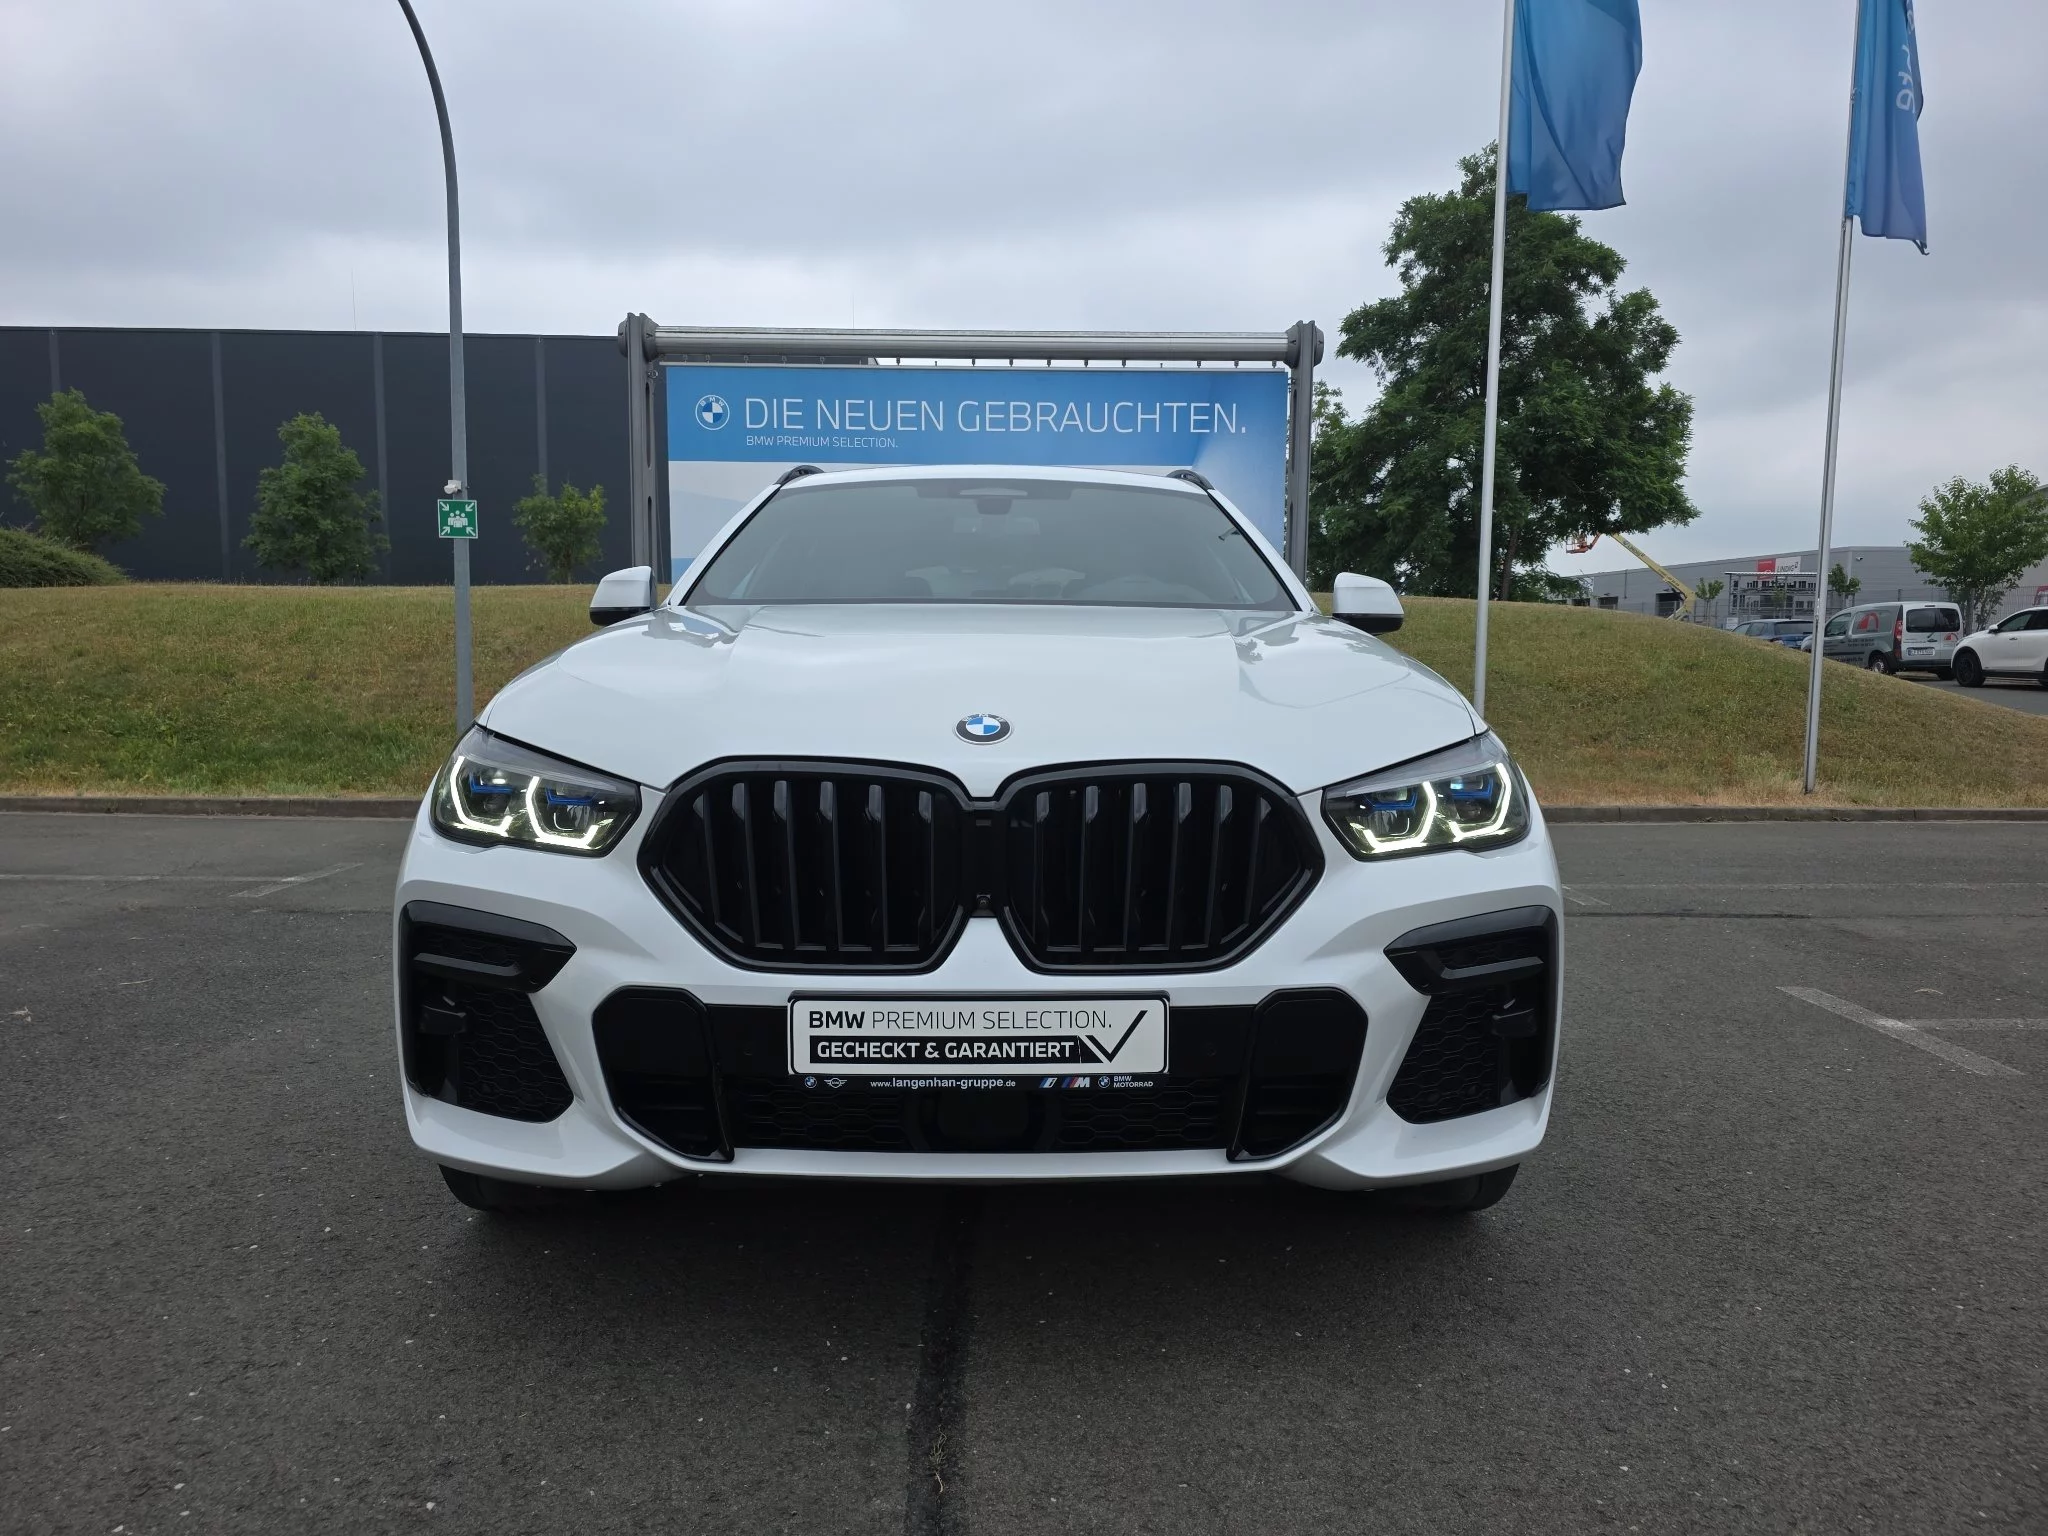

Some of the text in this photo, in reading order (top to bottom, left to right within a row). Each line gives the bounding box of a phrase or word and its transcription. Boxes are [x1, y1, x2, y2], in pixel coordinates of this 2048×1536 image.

[745, 398, 1246, 433] DIE NEUEN GEBRAUCHTEN.
[746, 435, 899, 448] BMW PREMIUM SELECTION.
[809, 1010, 1112, 1029] BMW PREMIUM SELECTION.
[817, 1041, 1075, 1058] GECHECKT & GARANTIERT
[870, 1077, 1016, 1089] www.langenhan-gruppe.de
